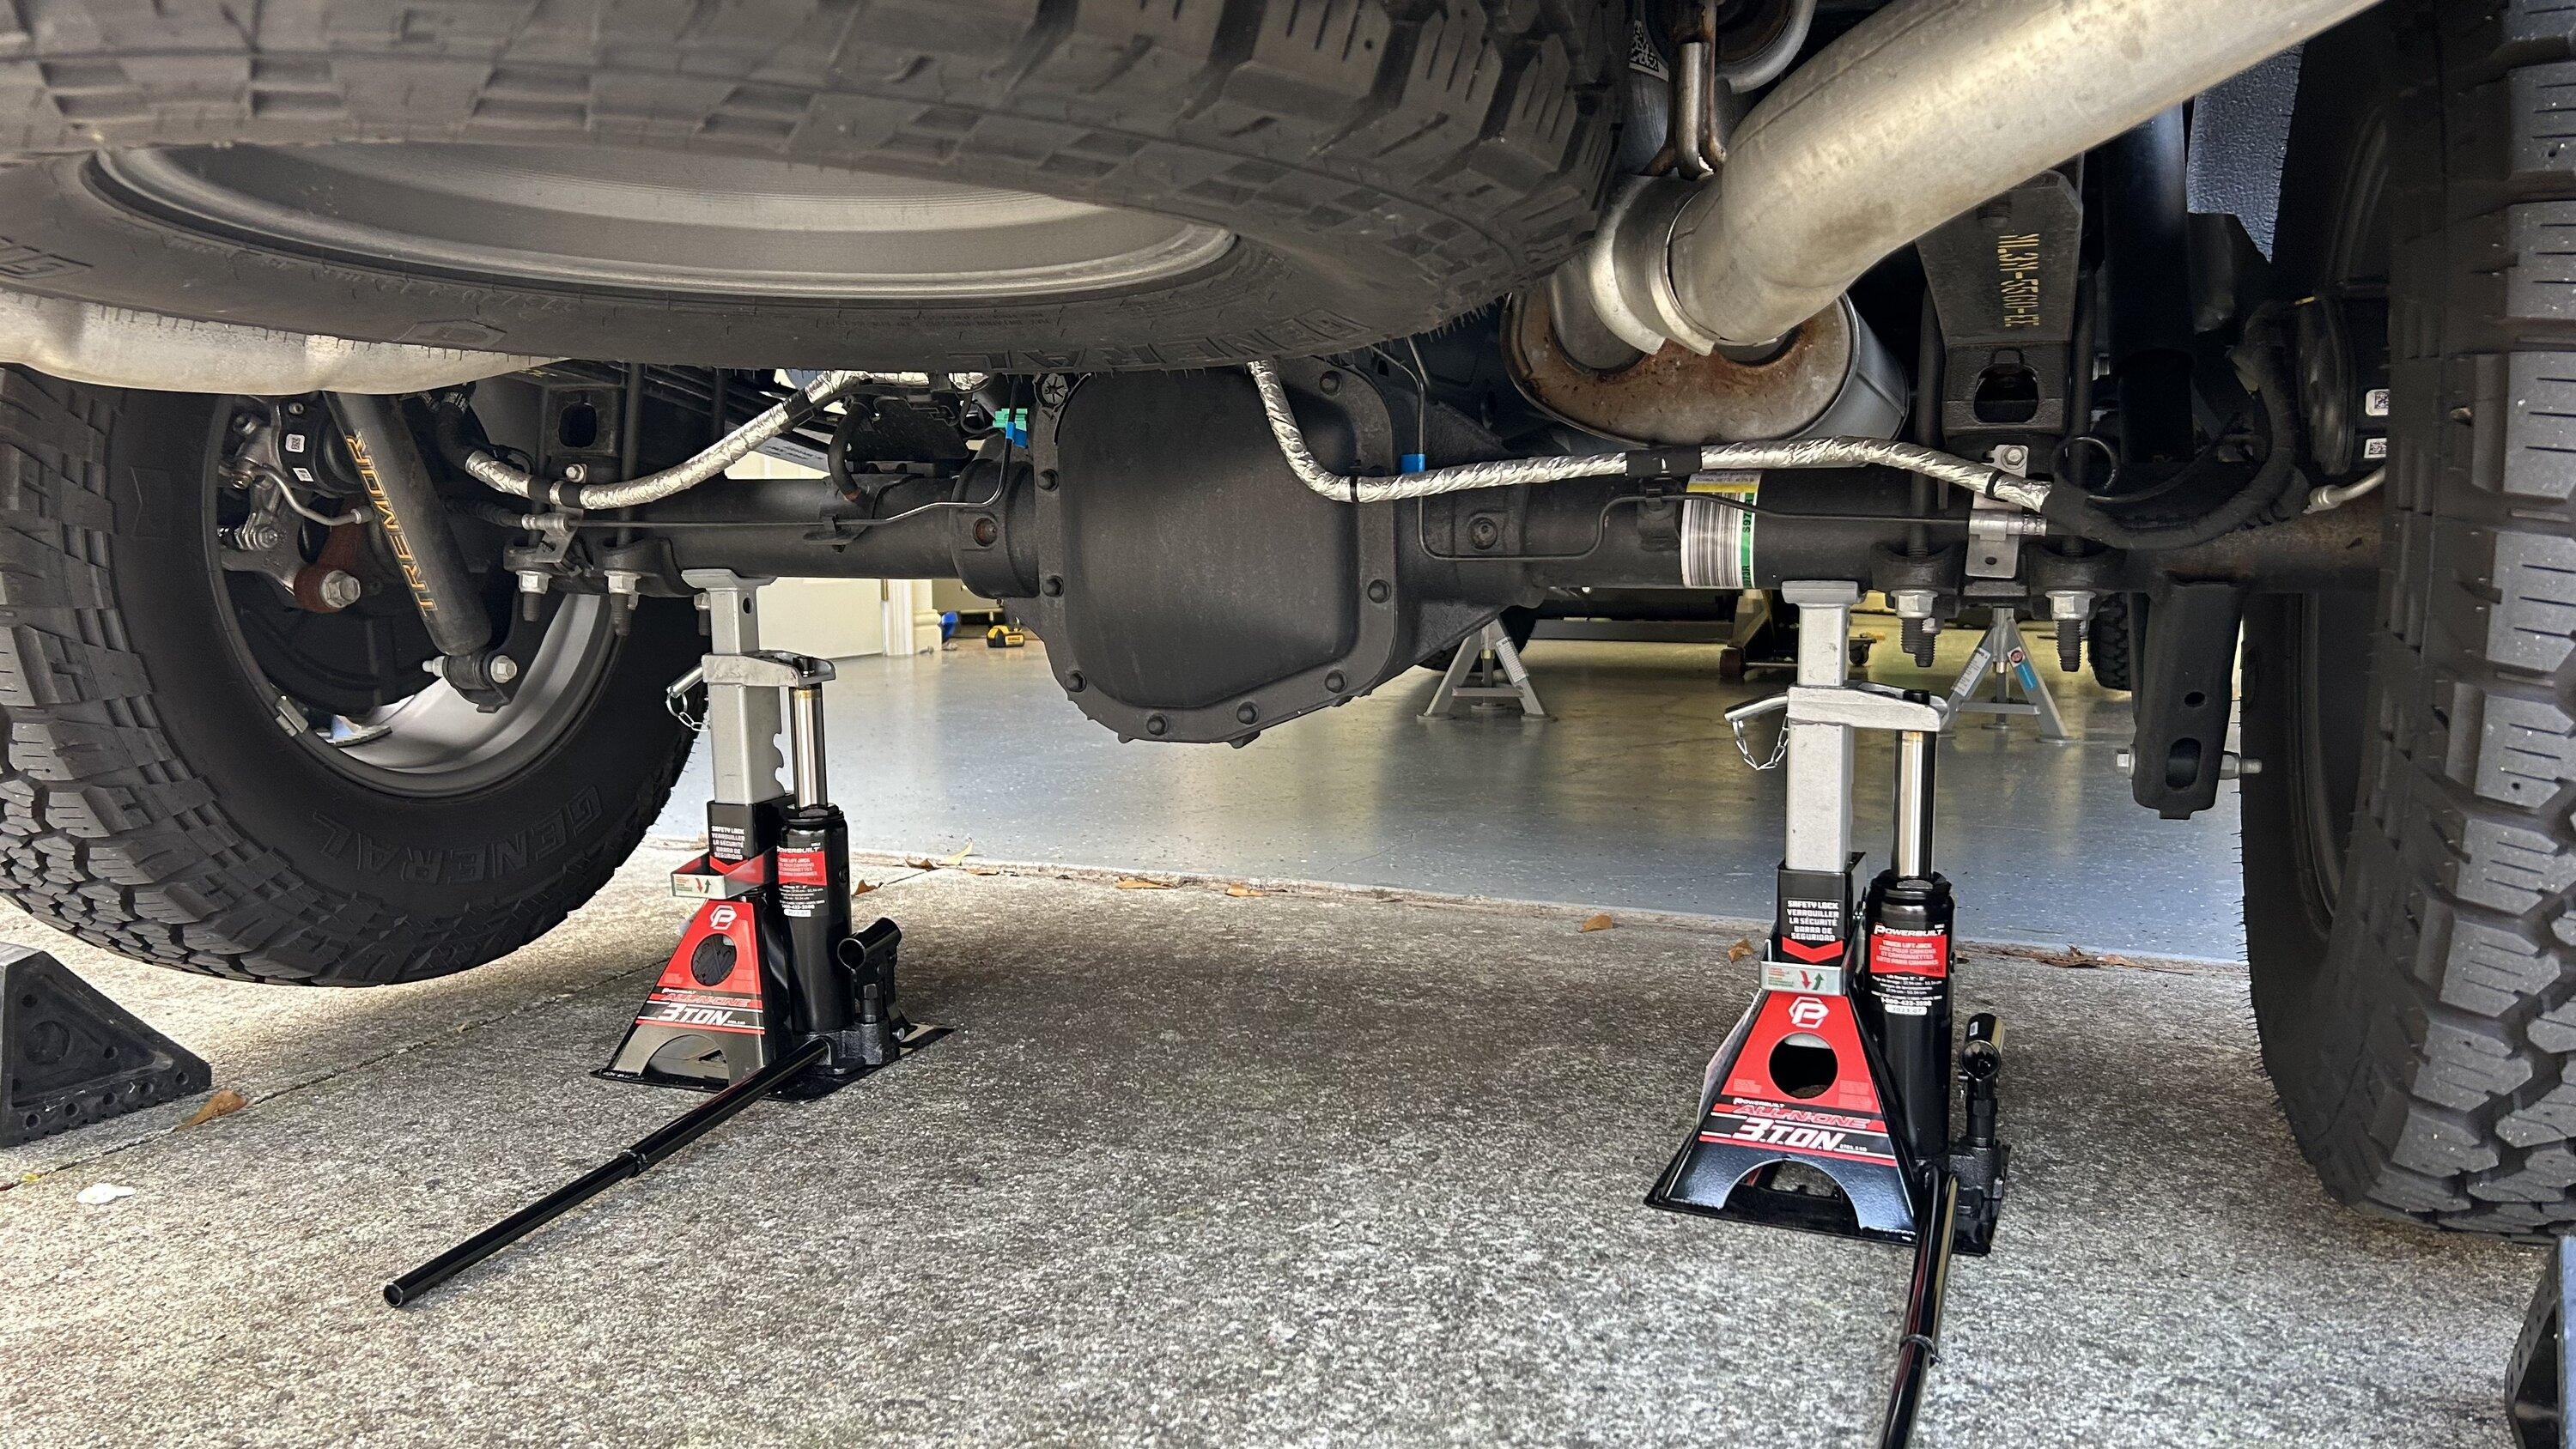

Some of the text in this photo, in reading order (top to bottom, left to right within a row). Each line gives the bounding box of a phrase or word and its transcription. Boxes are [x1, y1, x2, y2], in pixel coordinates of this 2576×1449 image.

[1743, 497, 1754, 533] S97R
[346, 432, 437, 616] TREMOR
[313, 783, 602, 886] GENERAL
[1787, 909, 1839, 918] VERROUILLER
[1800, 916, 1838, 926] SÉCURITÉ
[1791, 932, 1835, 942] SEGURIDAD
[1874, 925, 1944, 937] POWERBUILT
